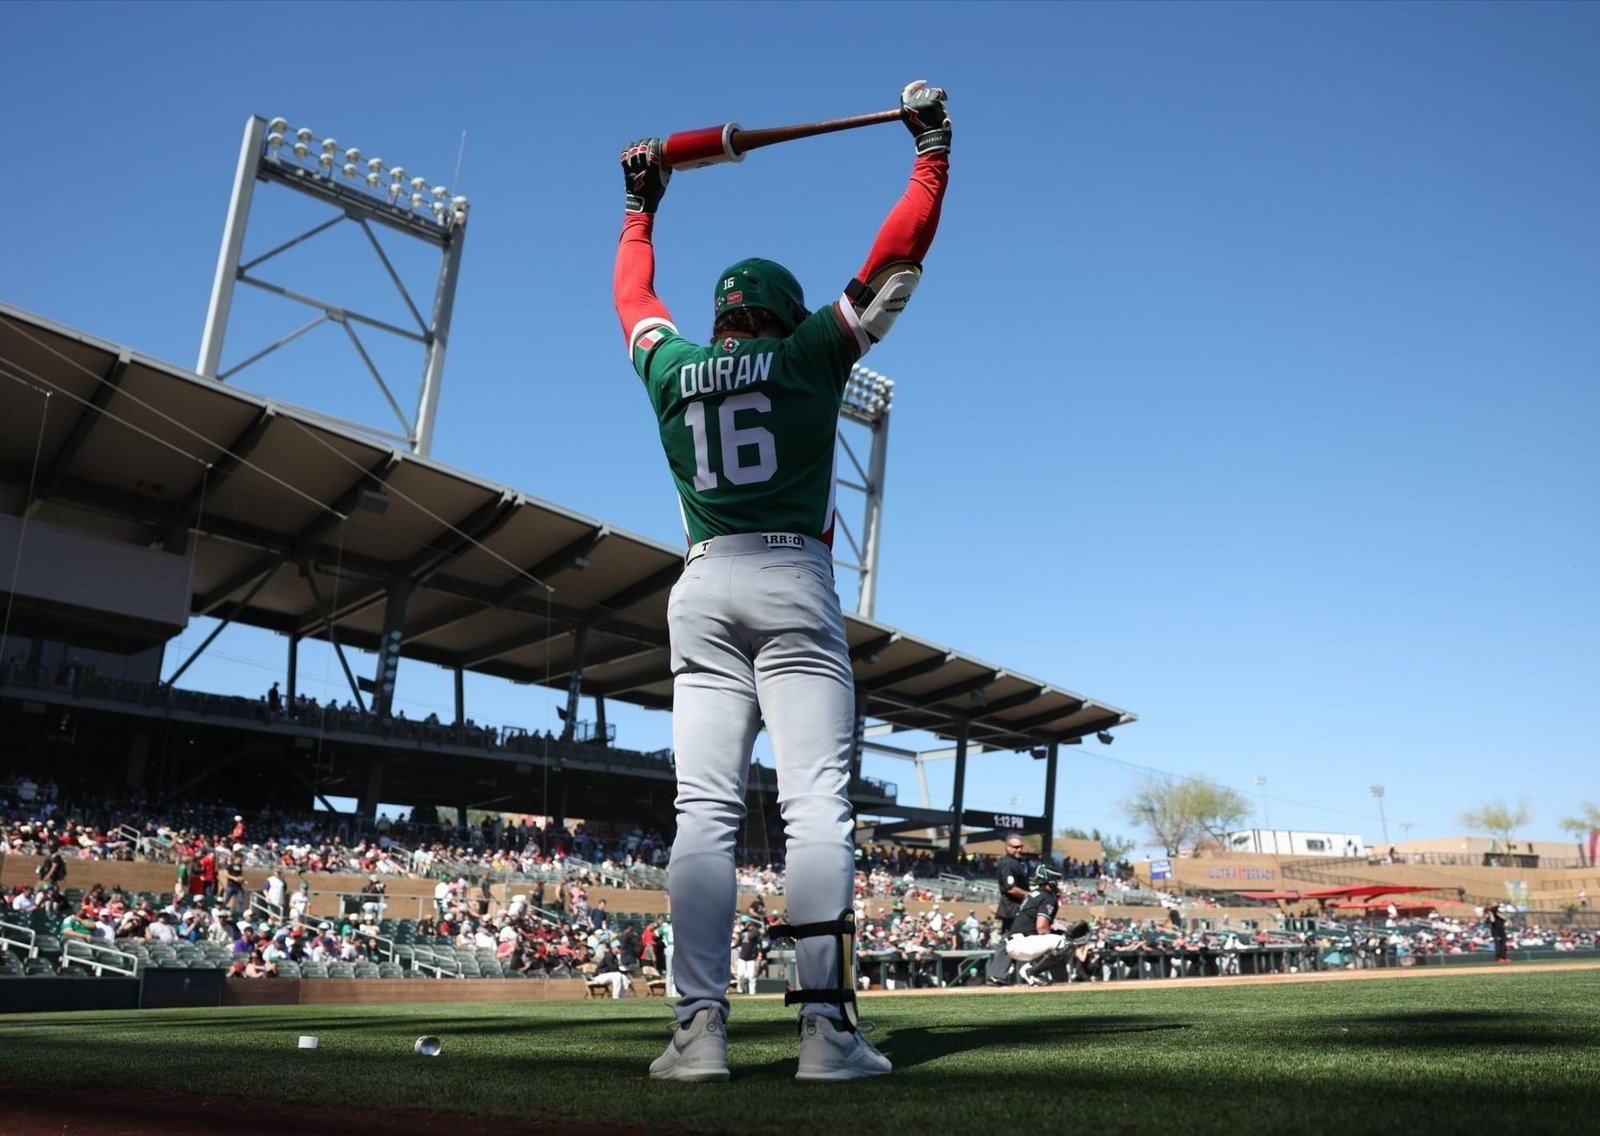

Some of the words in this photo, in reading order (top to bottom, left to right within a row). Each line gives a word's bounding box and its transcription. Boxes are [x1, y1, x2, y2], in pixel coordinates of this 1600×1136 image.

[723, 276, 735, 290] 16
[680, 352, 774, 398] DURAN
[684, 391, 778, 492] 16
[994, 815, 1010, 828] 1:12
[1011, 816, 1024, 829] PM
